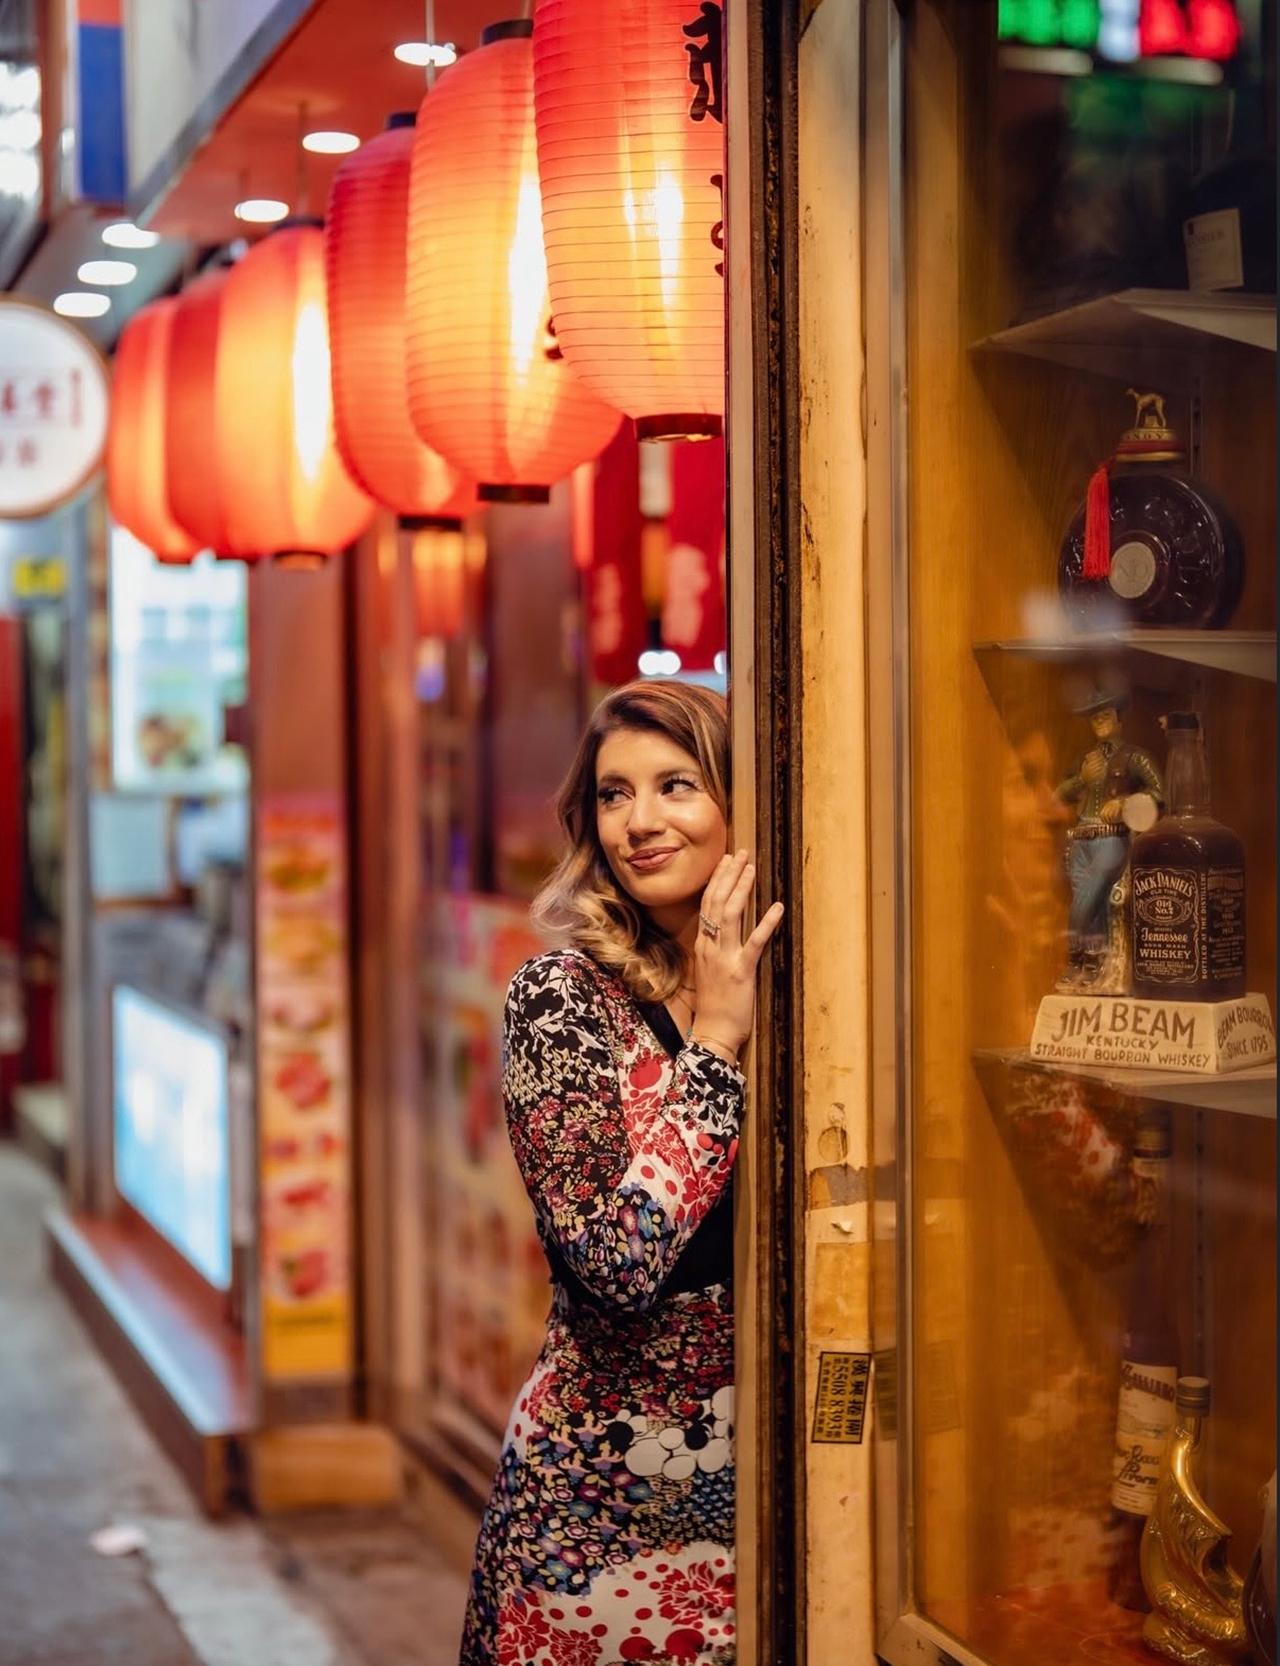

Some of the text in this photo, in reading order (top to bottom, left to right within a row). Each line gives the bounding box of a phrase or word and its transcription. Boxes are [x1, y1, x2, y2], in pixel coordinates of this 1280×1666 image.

[1135, 871, 1194, 898] JACK DANIEL'S
[1139, 948, 1191, 960] WHISKEY
[1051, 1002, 1196, 1050] JIM BEAM
[1217, 1009, 1237, 1049] BEAM
[1035, 1042, 1088, 1060] STRAIGHT
[1157, 1052, 1212, 1069] WHISKEY
[1086, 1034, 1160, 1051] KENTUCKY
[1226, 1038, 1249, 1060] SINCE
[831, 1364, 849, 1396] 5508
[828, 1399, 846, 1430] 8393
